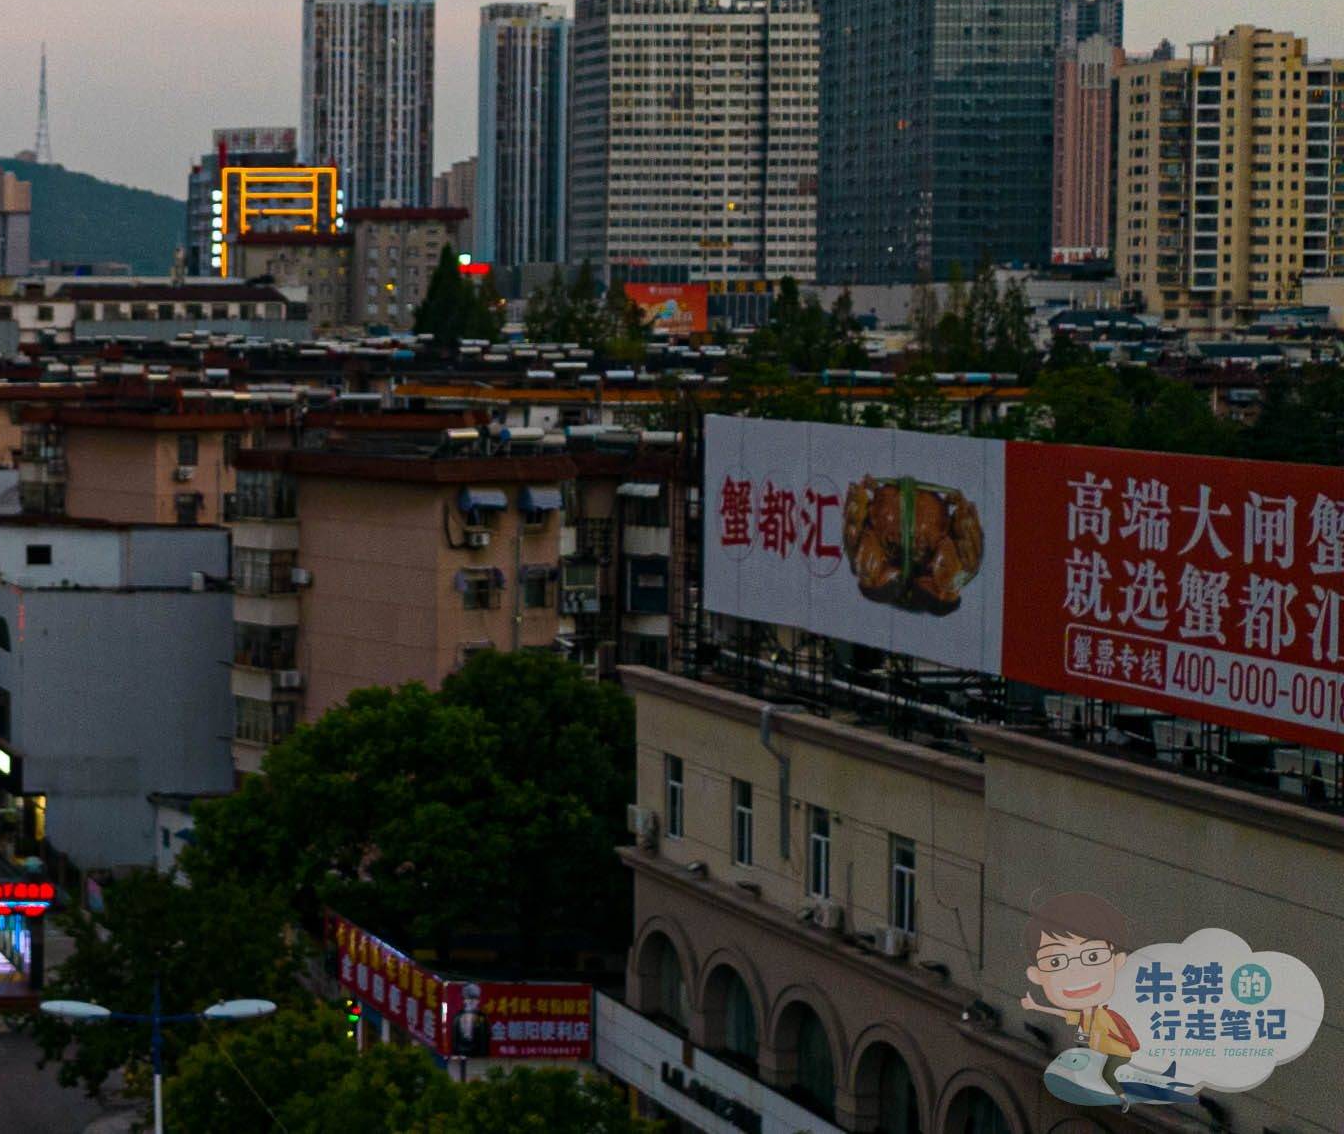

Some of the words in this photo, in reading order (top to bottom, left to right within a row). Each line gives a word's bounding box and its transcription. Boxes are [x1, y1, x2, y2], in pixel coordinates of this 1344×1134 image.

[719, 474, 843, 560] 蟹都汇
[1072, 633, 1163, 689] 蟹票专线
